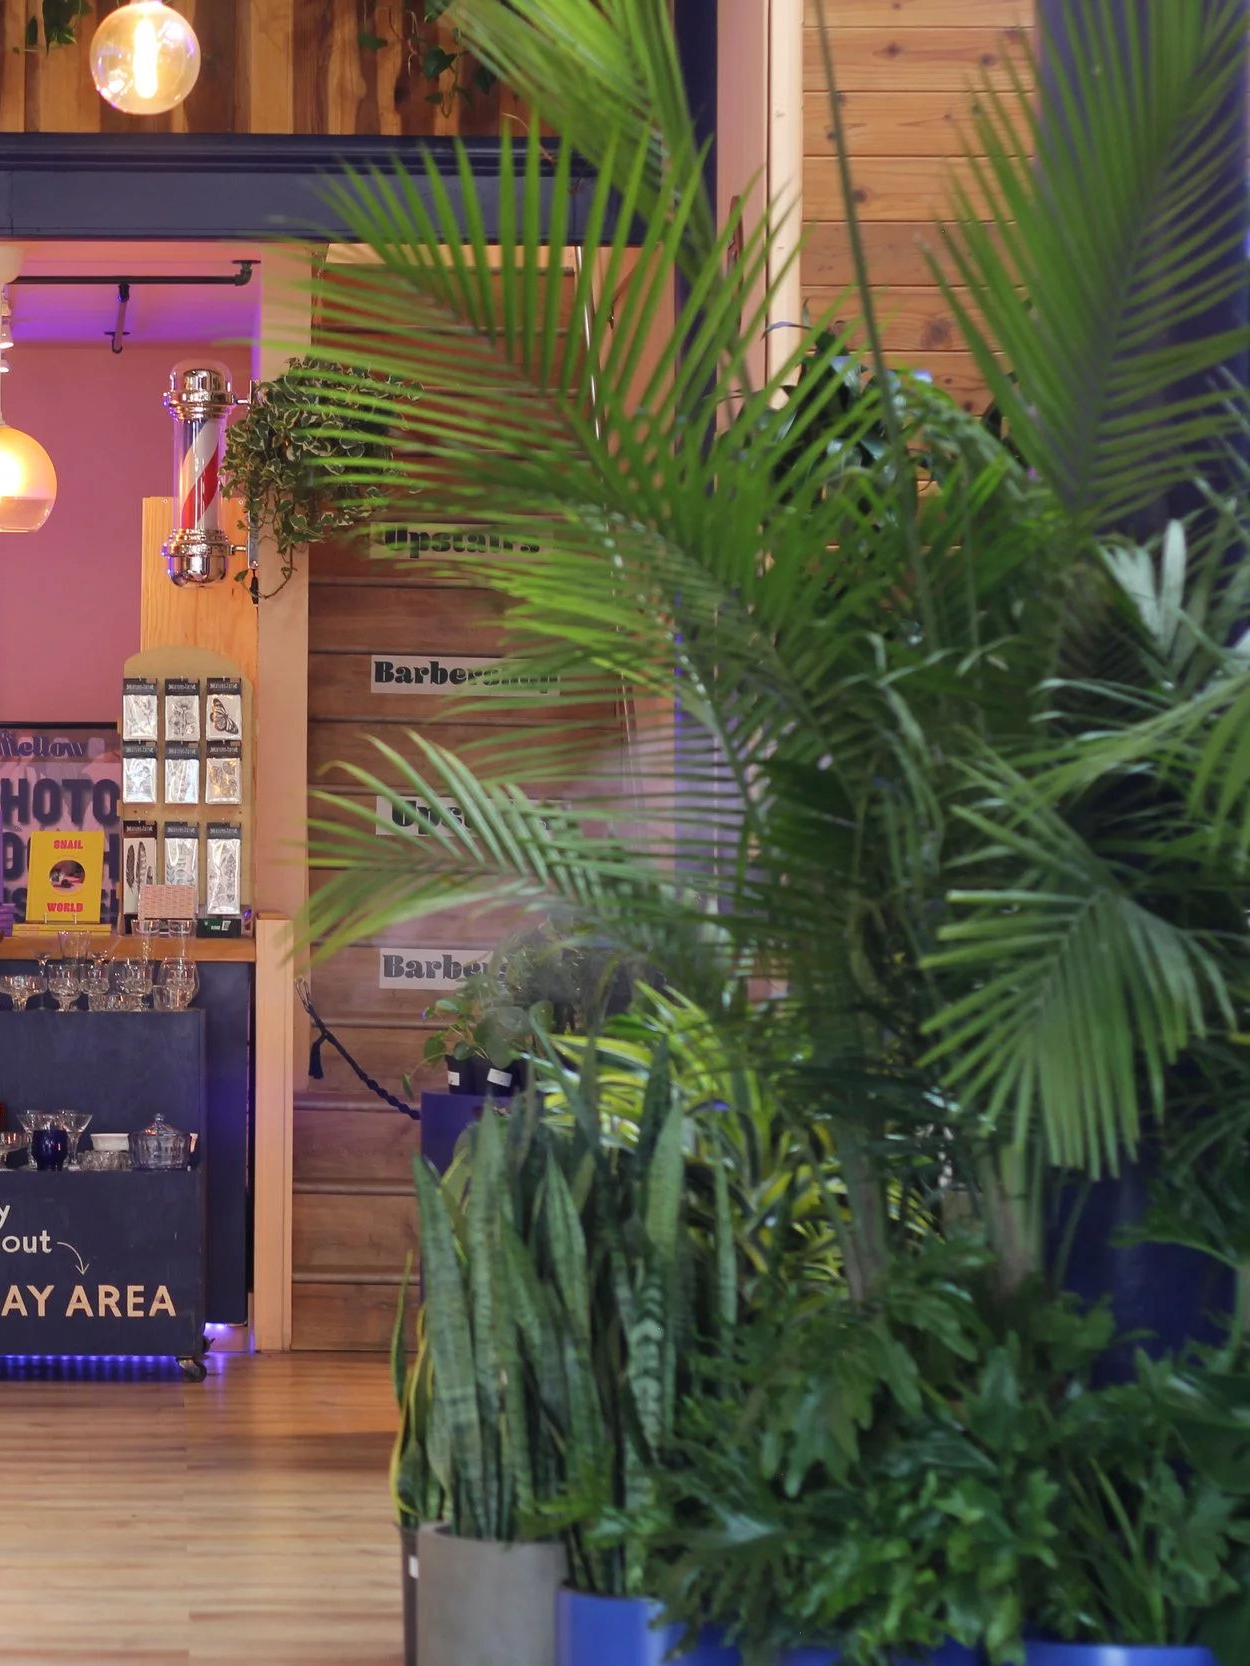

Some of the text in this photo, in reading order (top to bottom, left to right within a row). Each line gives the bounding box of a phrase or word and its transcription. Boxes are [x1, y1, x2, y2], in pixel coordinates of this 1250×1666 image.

[374, 660, 559, 694] Barbers
[53, 839, 83, 850] SNAIL
[46, 902, 83, 913] WORLD
[65, 1284, 177, 1317] AREA
